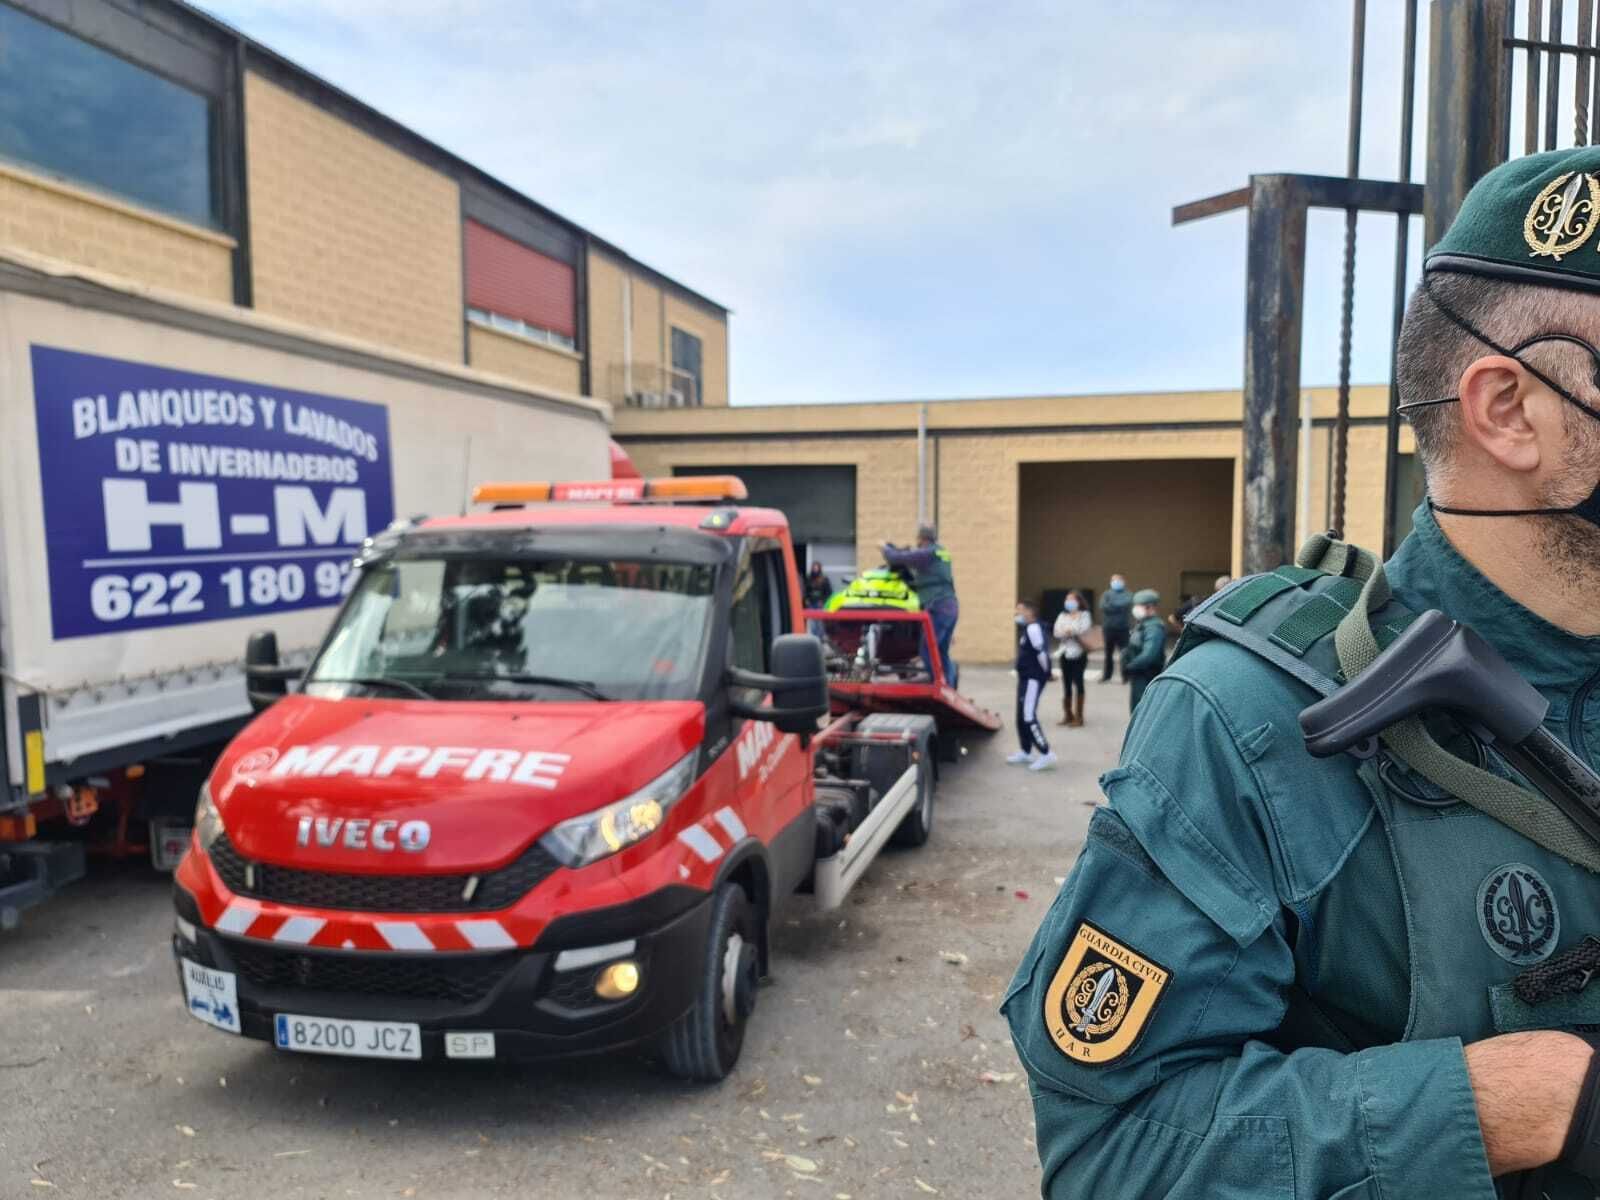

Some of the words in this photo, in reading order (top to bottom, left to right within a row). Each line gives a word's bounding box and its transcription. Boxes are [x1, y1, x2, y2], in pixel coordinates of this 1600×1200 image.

[73, 389, 255, 438] BLANQUEOS
[260, 397, 277, 430] Y
[283, 402, 379, 462] LAVADOS
[115, 438, 162, 473] DE
[168, 442, 358, 484] INVERNADEROS
[102, 477, 368, 552] H-M
[90, 570, 204, 622] 622
[220, 563, 305, 608] 180
[270, 745, 571, 790] MAPFRE
[296, 814, 432, 852] IVECO
[1079, 927, 1131, 966] GUARDIA
[1132, 960, 1163, 985] CIVIL
[294, 1021, 356, 1048] 8200
[366, 1027, 414, 1053] JCZ
[452, 1036, 490, 1054] SP
